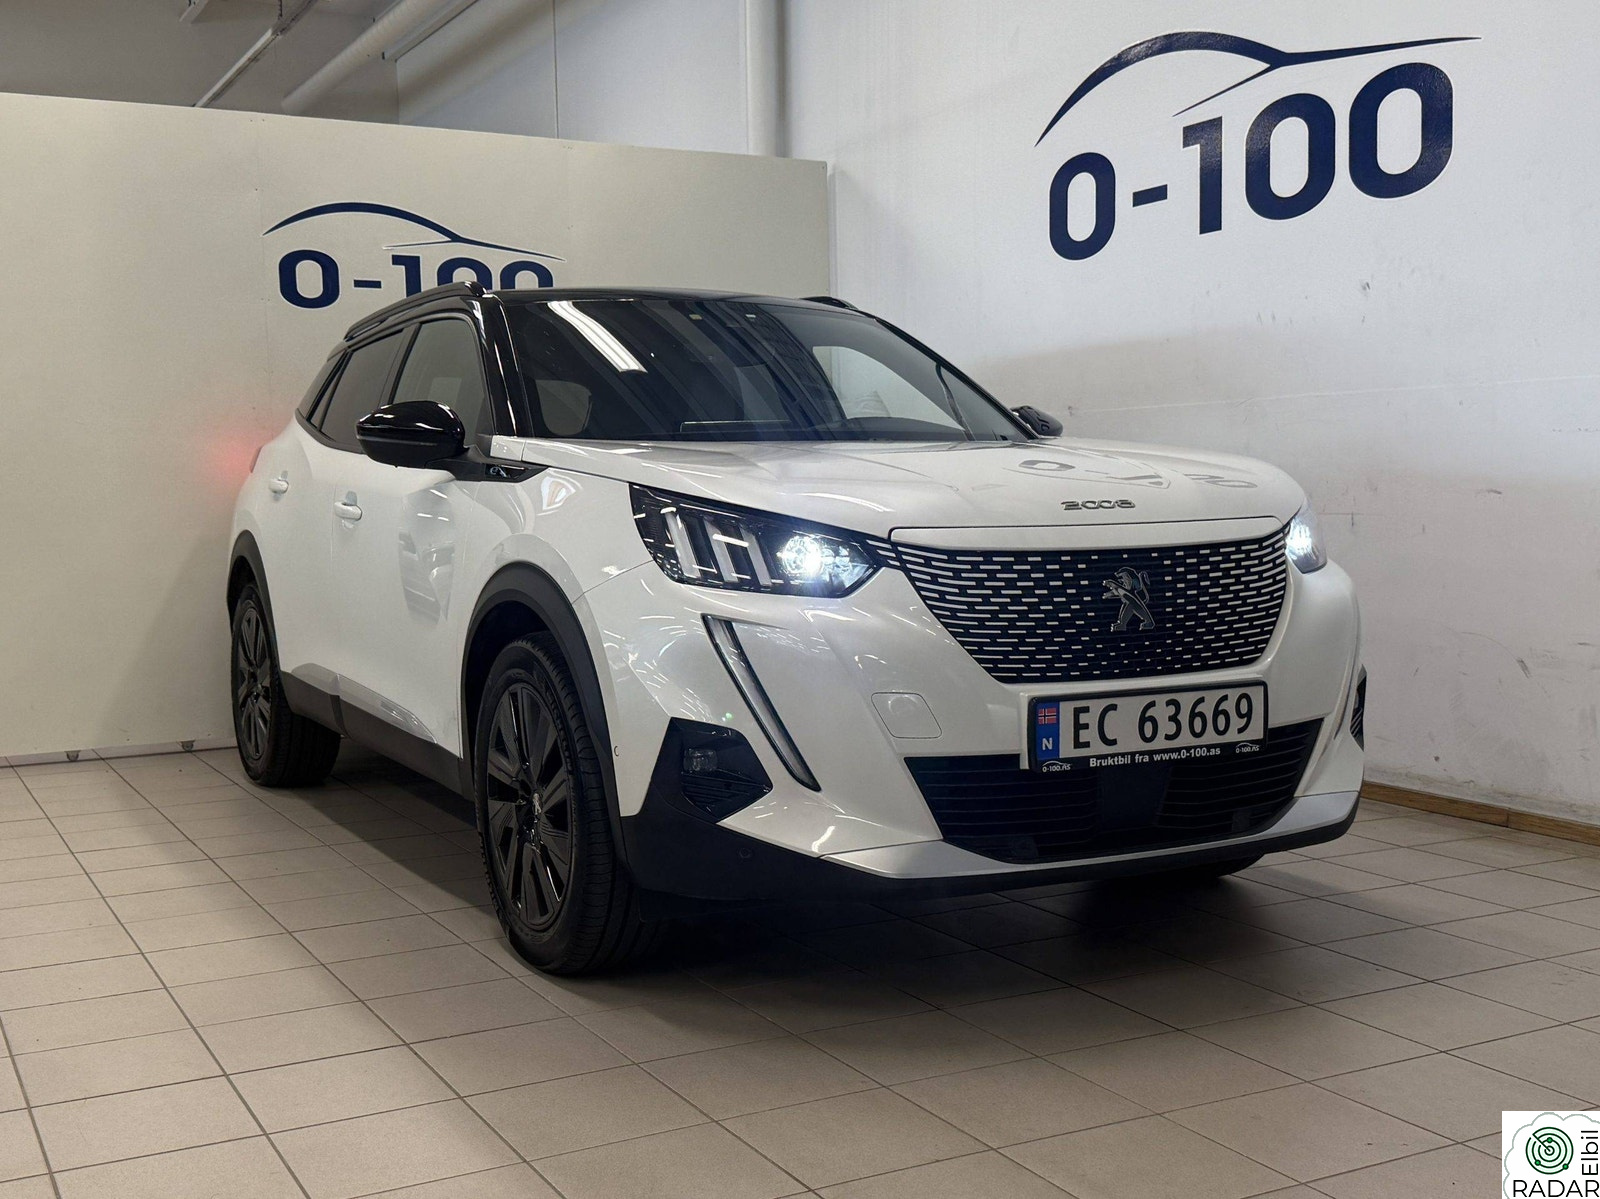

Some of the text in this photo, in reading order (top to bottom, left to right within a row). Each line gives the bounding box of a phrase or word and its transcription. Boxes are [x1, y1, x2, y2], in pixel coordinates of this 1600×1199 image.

[1049, 62, 1453, 260] 0-100
[1061, 499, 1136, 511] 2008
[1072, 692, 1254, 750] EC 63669
[1041, 737, 1053, 750] N
[1089, 747, 1221, 768] Bruktbil fra www.0-100.as
